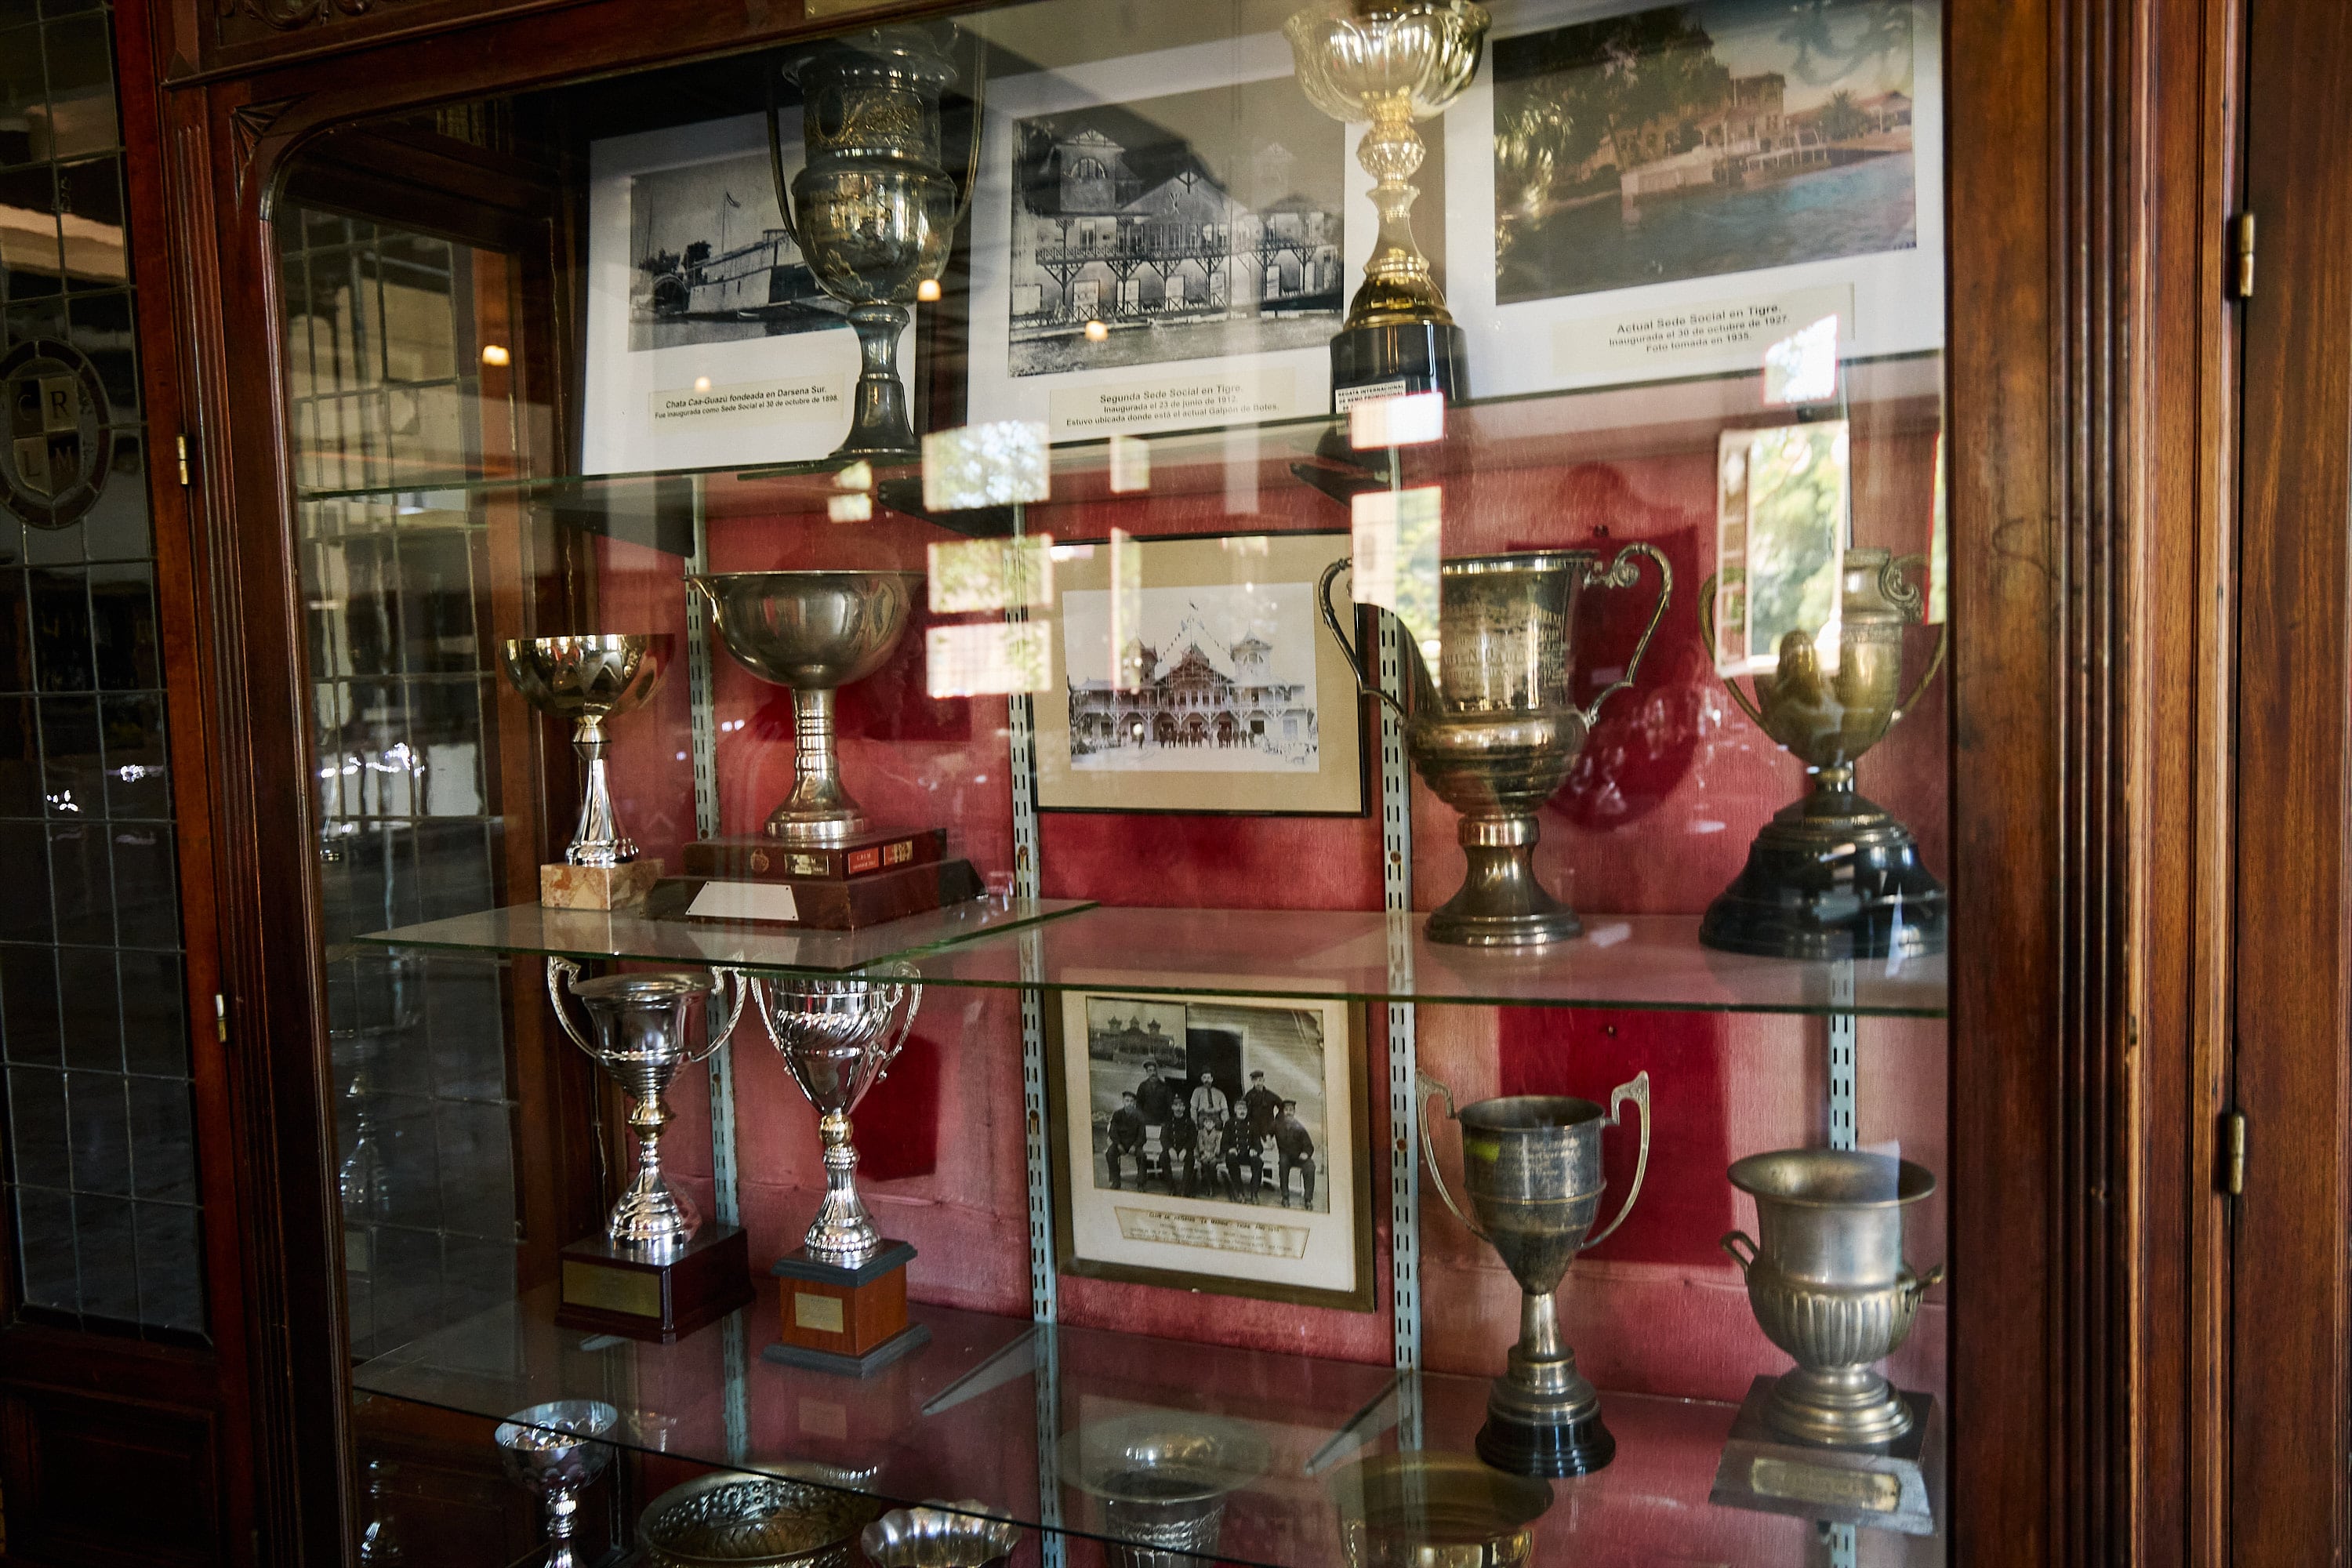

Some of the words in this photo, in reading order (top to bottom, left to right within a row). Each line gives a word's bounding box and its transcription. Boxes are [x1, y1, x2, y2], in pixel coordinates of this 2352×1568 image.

[1617, 319, 1653, 333] Actual
[1657, 316, 1686, 328] Sede
[1690, 310, 1725, 325] Social
[1610, 332, 1664, 347] Inaugurada
[1667, 329, 1675, 339] el
[1693, 326, 1704, 336] de
[1708, 322, 1744, 333] octubre
[1748, 319, 1760, 328] de
[1646, 343, 1668, 353] Foto
[1671, 338, 1708, 350] tomada
[666, 400, 687, 408] Chata
[729, 391, 764, 401] fondeada
[777, 387, 809, 397] Darsena
[811, 385, 827, 394] Sur.
[1100, 392, 1141, 405] Segunda
[1144, 389, 1167, 399] Sede
[1170, 387, 1199, 397] Social
[1361, 384, 1403, 394] INTERNACIONAL
[50, 390, 69, 419] R
[720, 404, 736, 412] Sede
[738, 401, 757, 410] Social
[785, 397, 810, 406] octubre
[1066, 417, 1093, 426] Estuvo
[1094, 415, 1125, 425] ubicada
[1127, 412, 1152, 421] donde
[1154, 410, 1171, 419] está
[1173, 409, 1180, 418] el
[1182, 407, 1207, 417] actual
[1209, 405, 1238, 416] Galpón
[1241, 404, 1250, 412] de
[1104, 404, 1148, 414] Inaugurada
[1171, 399, 1180, 408] de
[1182, 397, 1203, 408] junio
[24, 451, 41, 477] L
[55, 445, 75, 472] M
